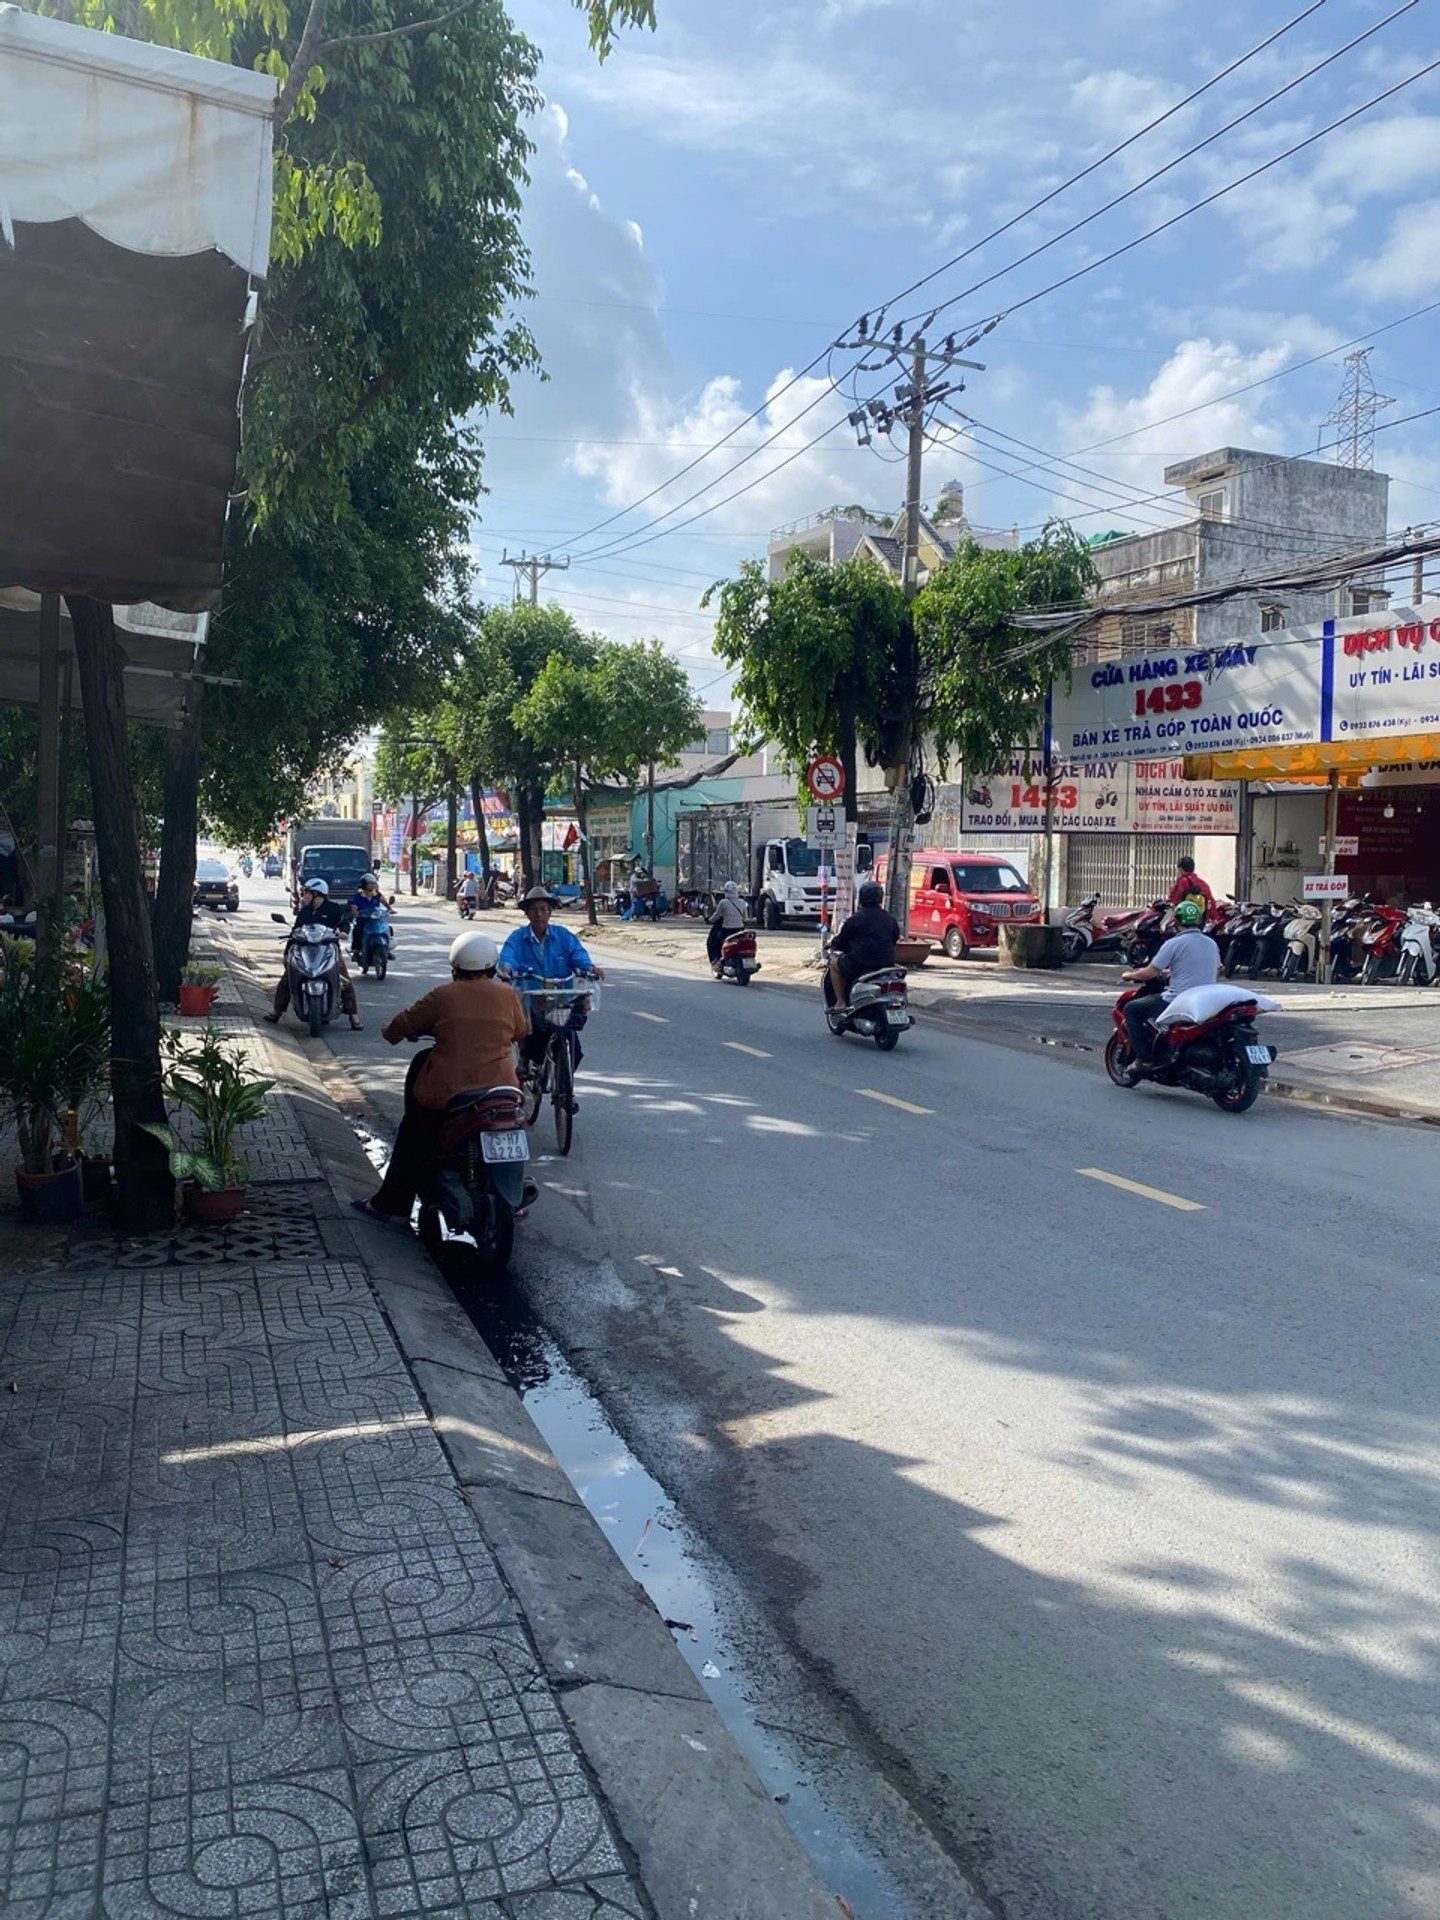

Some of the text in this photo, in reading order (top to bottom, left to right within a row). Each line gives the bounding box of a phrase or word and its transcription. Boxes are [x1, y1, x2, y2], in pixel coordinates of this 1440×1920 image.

[1344, 629, 1391, 660] DỊCH
[1395, 621, 1424, 653] VỤ
[1091, 663, 1124, 688] CỬA
[1129, 659, 1178, 683] HÀNG
[1184, 653, 1210, 674] XE
[1349, 672, 1366, 688] UY
[1371, 666, 1391, 685] TÍN
[1403, 662, 1424, 681] LÃI
[1135, 681, 1203, 716] 1433
[1072, 703, 1283, 747] BÁN XE TRẢ GÓP TOÀN QUỐC
[1135, 762, 1167, 782] DỊCH
[1206, 788, 1217, 798] XE
[1220, 785, 1239, 798] MÁY
[968, 815, 993, 826] TRAO
[995, 810, 1011, 827] ĐỔI
[1018, 815, 1038, 827] MUA
[1041, 815, 1060, 827] BN
[1062, 813, 1080, 827] CÁC
[1082, 816, 1102, 830] LOẠI
[1104, 816, 1117, 827] XE
[1305, 881, 1347, 891] XE TRẢ GÓP
